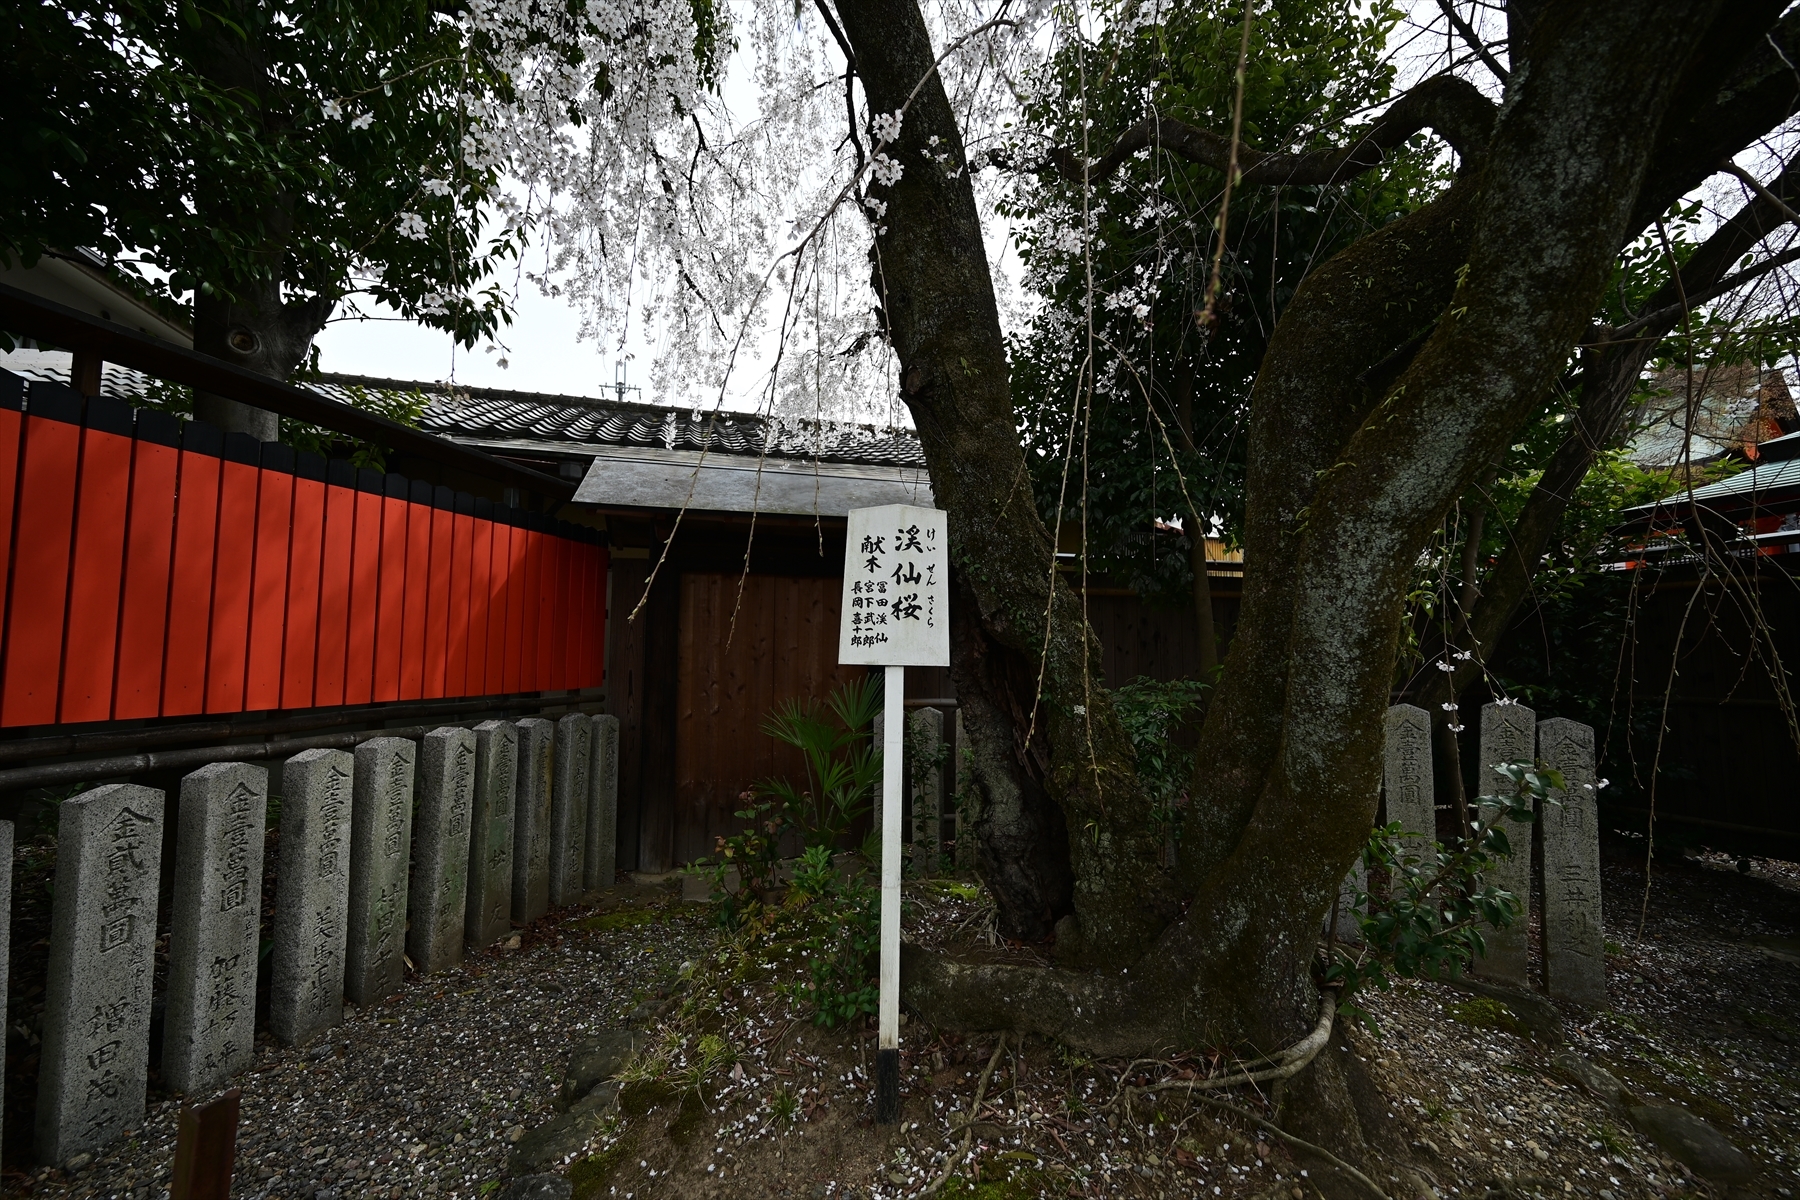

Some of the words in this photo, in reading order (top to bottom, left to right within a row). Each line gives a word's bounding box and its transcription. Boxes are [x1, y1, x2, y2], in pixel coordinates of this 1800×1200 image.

[860, 535, 886, 573] 献木
[851, 580, 863, 648] 長岡喜十郎
[863, 580, 876, 649] 宮下武一郎
